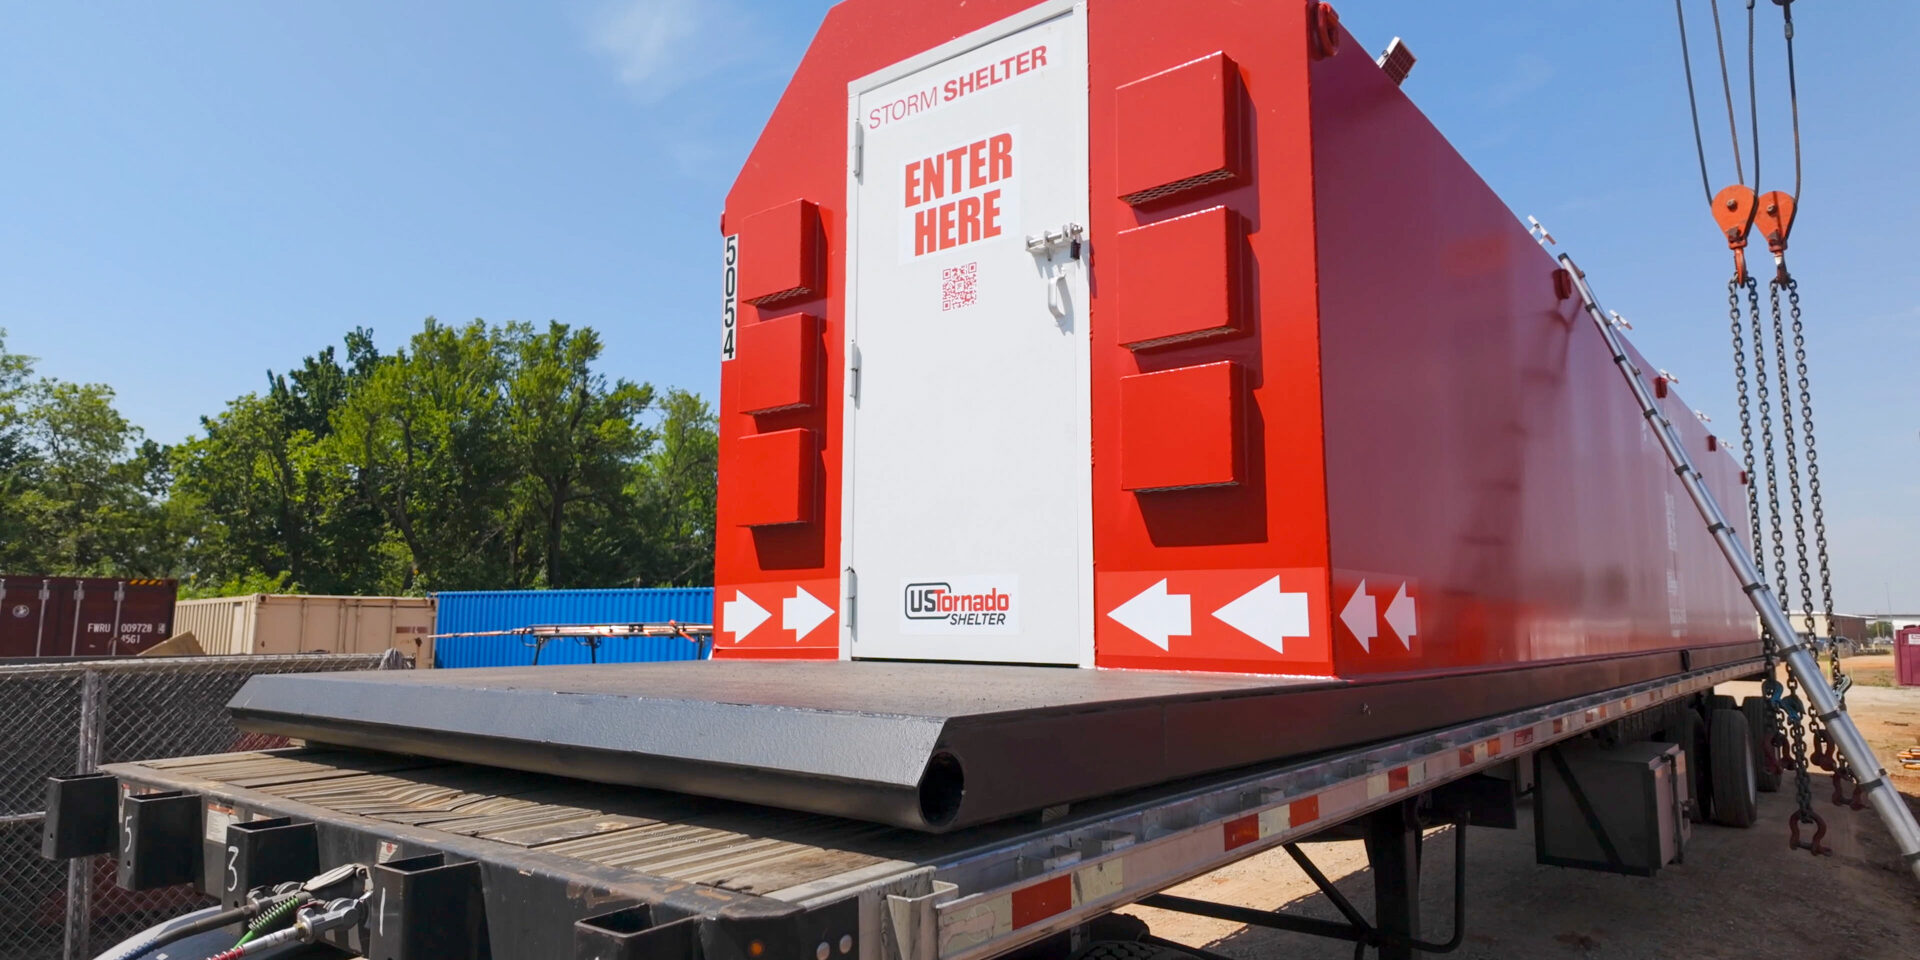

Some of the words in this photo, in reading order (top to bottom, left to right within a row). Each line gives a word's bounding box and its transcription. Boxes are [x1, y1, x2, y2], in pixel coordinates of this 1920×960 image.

[869, 86, 938, 129] STORM
[943, 45, 1048, 102] SHELTER
[904, 132, 1013, 208] ENTER
[914, 188, 1002, 257] HERE
[723, 235, 737, 360] 5054
[950, 612, 1006, 626] SHELTER
[124, 815, 133, 853] 5
[227, 845, 240, 892] 3
